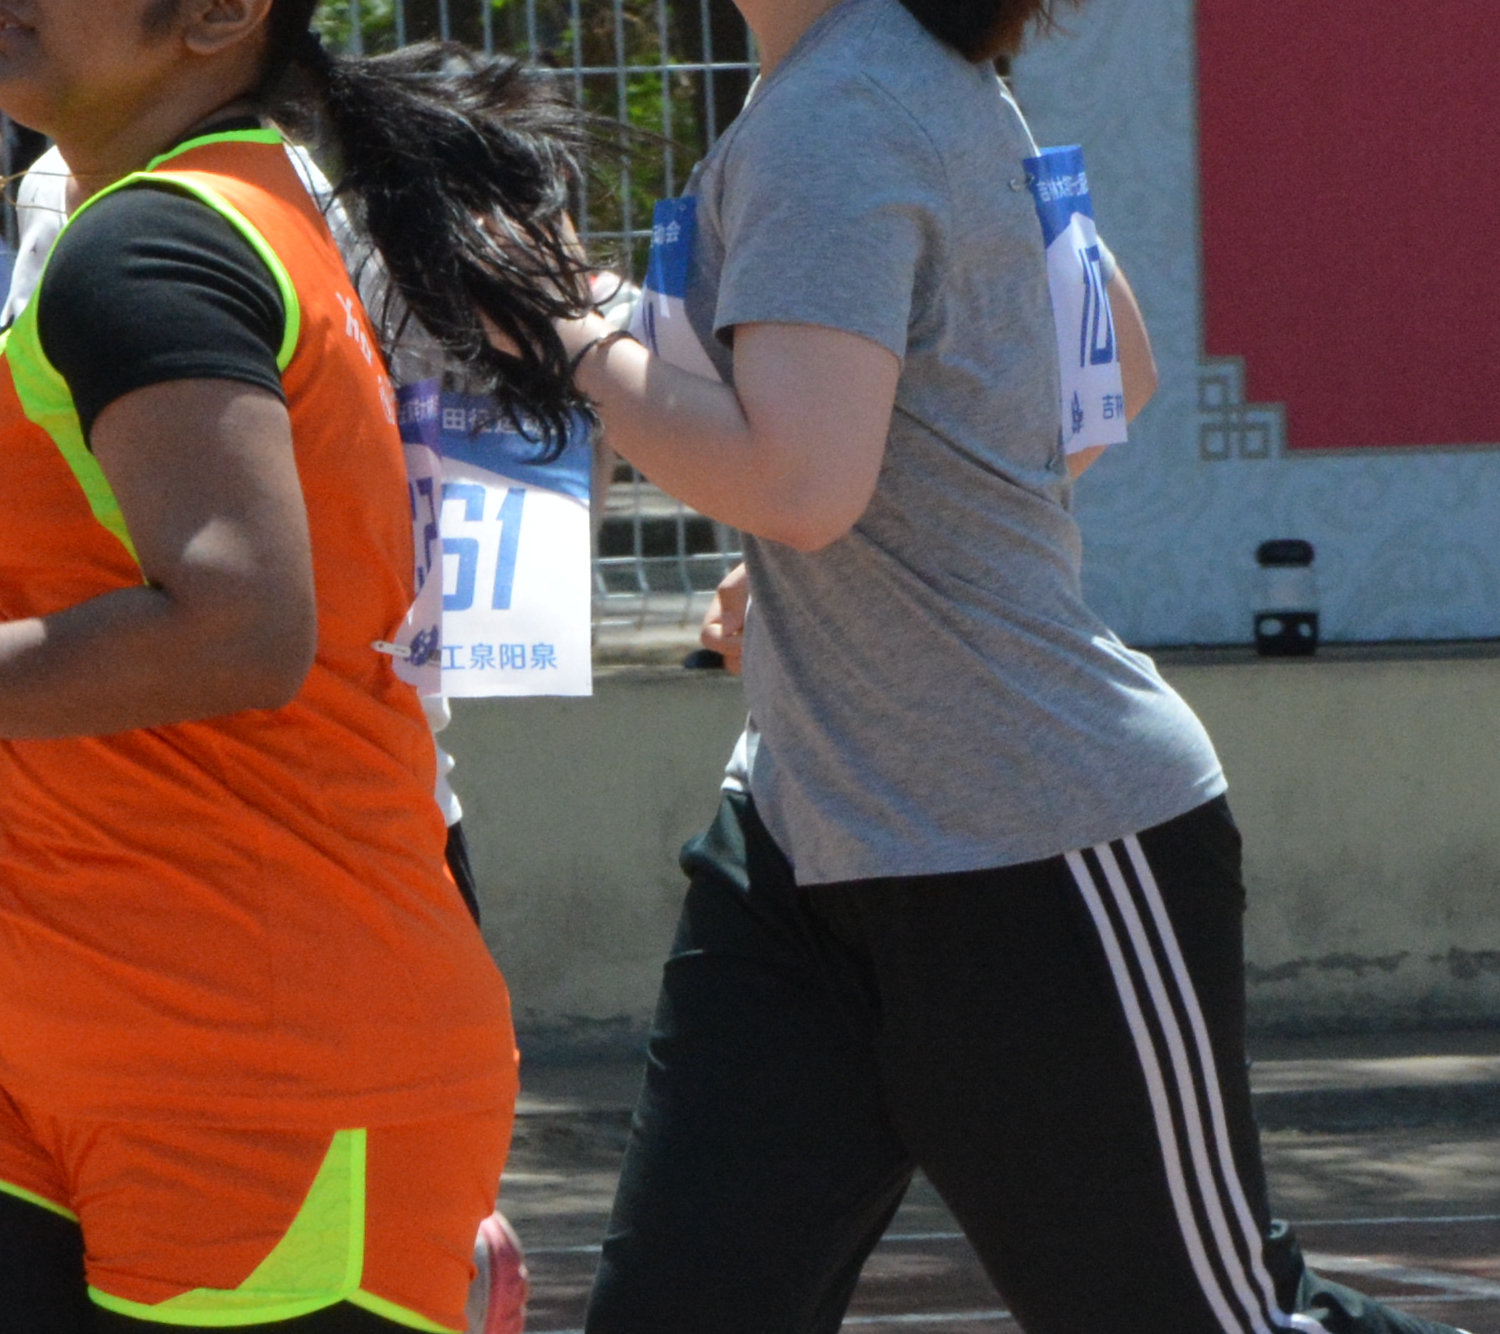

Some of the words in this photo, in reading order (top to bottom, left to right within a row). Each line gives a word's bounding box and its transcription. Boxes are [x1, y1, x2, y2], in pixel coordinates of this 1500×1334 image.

[441, 483, 526, 612] 61
[441, 642, 558, 671] 工泉阳泉
